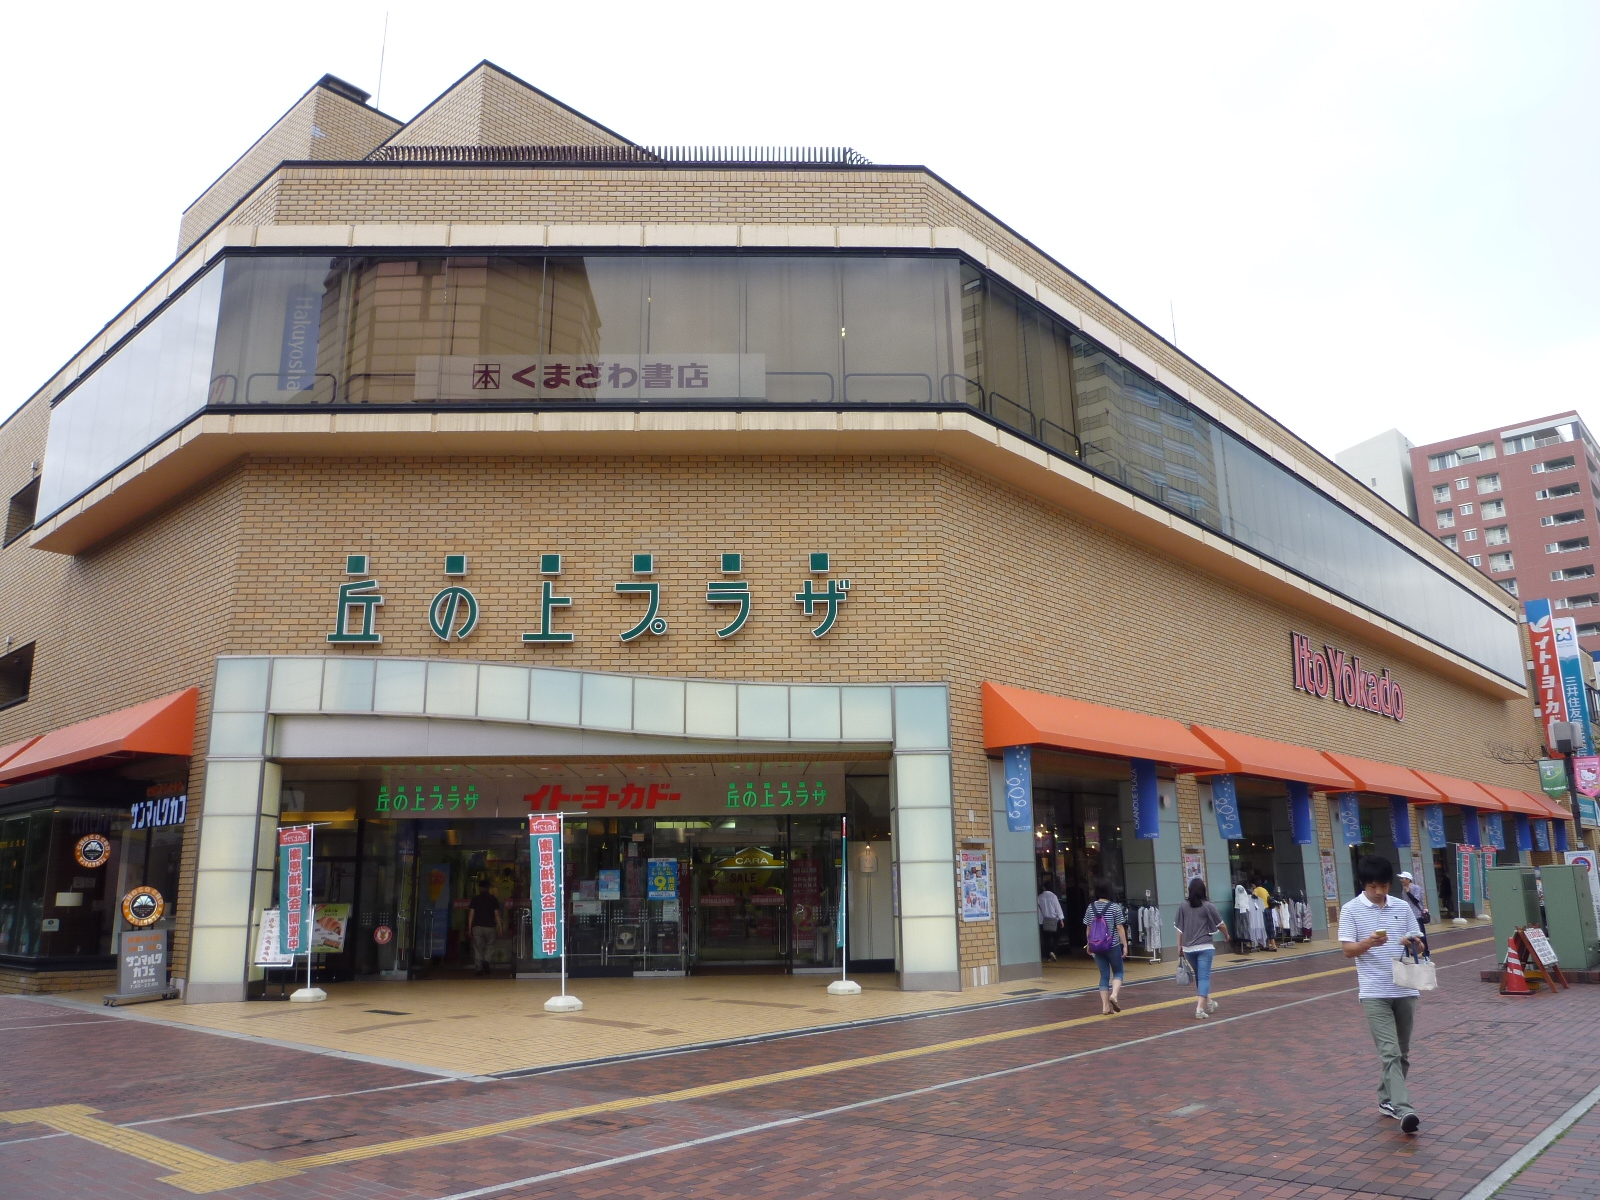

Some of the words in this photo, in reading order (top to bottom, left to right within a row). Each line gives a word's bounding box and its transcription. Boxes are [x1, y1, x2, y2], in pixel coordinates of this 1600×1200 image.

[288, 296, 315, 391] Hakuyosha
[512, 363, 709, 391] くまざわ書店
[326, 578, 851, 644] 丘の上プラザ
[1534, 635, 1561, 724] イトーヨーカド
[375, 789, 479, 812] 丘の上プラザ
[523, 782, 682, 811] イトーヨーカドー
[726, 786, 827, 810] 丘の上プラザ
[735, 857, 769, 865] CARA
[730, 873, 757, 884] SALE
[126, 953, 163, 967] サンマルク
[133, 965, 156, 977] カフェ
